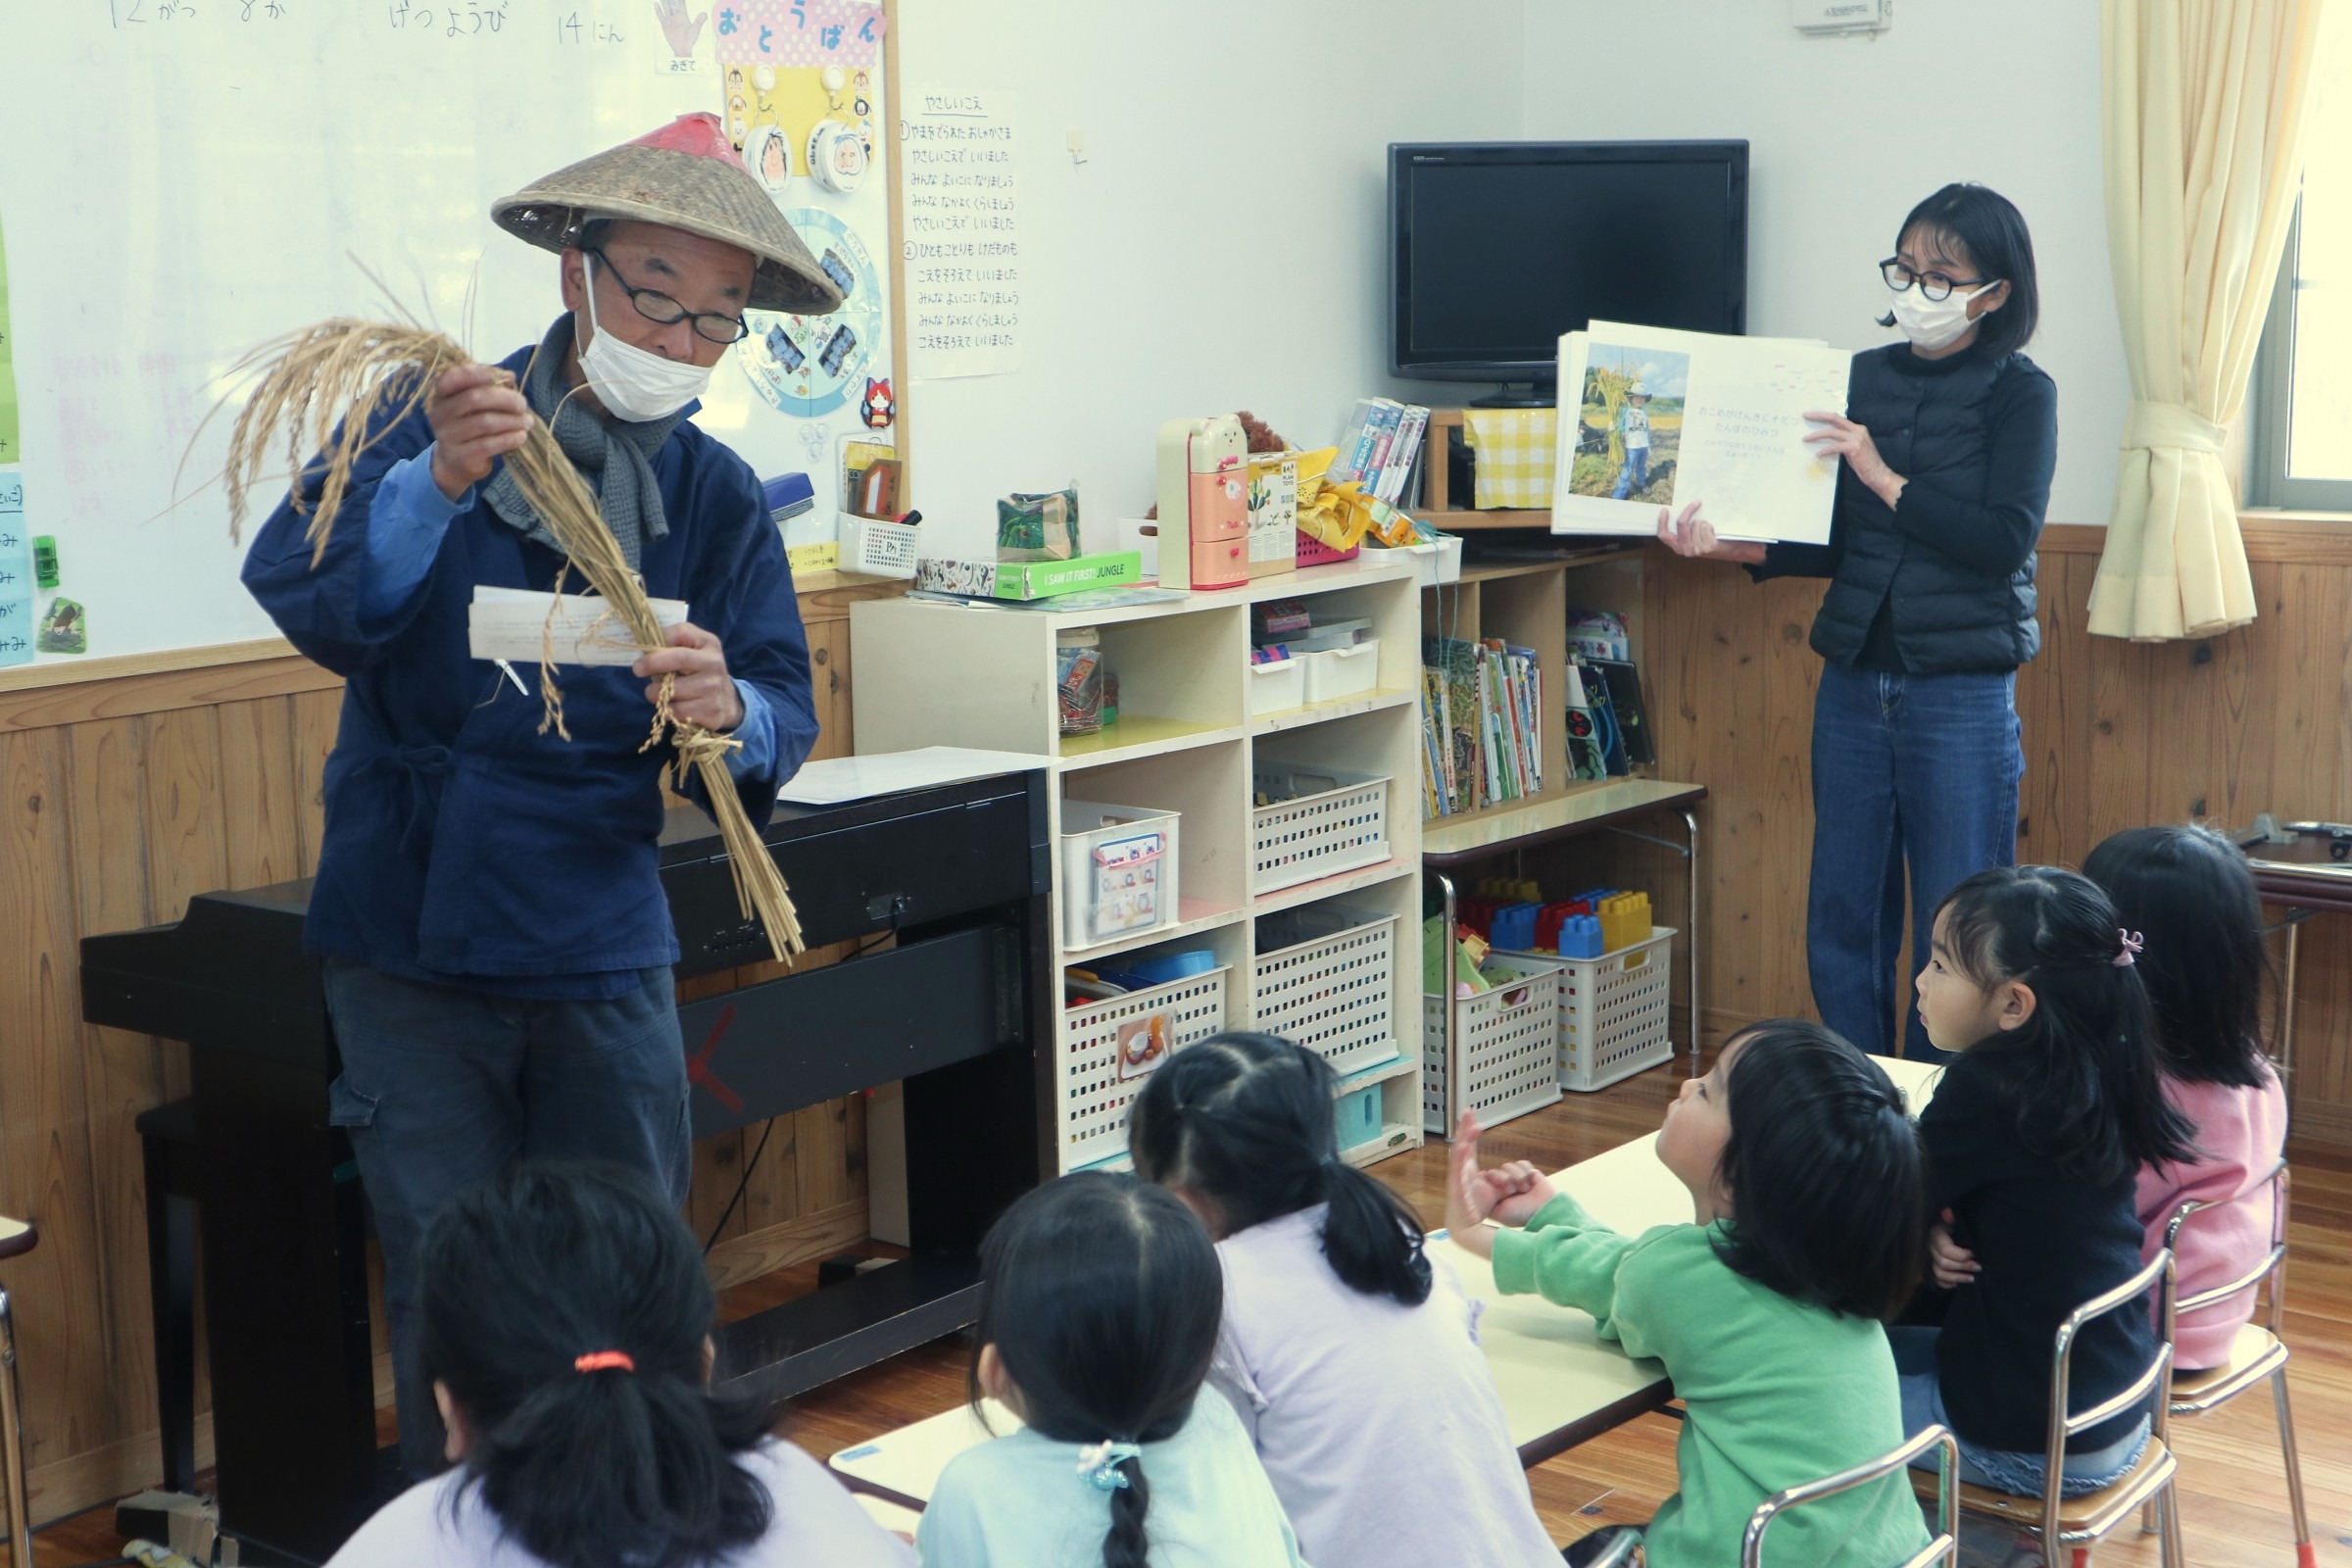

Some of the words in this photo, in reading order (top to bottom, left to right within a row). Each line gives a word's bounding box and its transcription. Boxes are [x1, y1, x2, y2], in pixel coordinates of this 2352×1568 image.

[669, 60, 696, 72] みぎて
[925, 95, 983, 111] やさしいこえ
[911, 148, 967, 164] やさしいこえで
[970, 150, 1009, 163] いいました
[910, 172, 938, 186] みんな
[942, 172, 971, 187] よいこに
[974, 174, 1013, 188] なりましょう
[911, 194, 937, 207] みんな
[912, 216, 969, 232] やさしいこえで
[973, 217, 1015, 231] いいました
[917, 268, 972, 283] こえをそろえて
[976, 268, 1017, 281] いいました
[917, 291, 943, 305] みんな
[946, 291, 976, 305] よいこに
[979, 290, 1019, 306] なりましょう
[918, 314, 943, 327] みんな
[917, 334, 971, 350] こえをそろえて
[975, 334, 1013, 347] いいました
[1049, 571, 1065, 585] SAW
[1065, 570, 1074, 583] IT
[1074, 567, 1096, 582] FIRST!
[1097, 564, 1125, 578] JUNGLE
